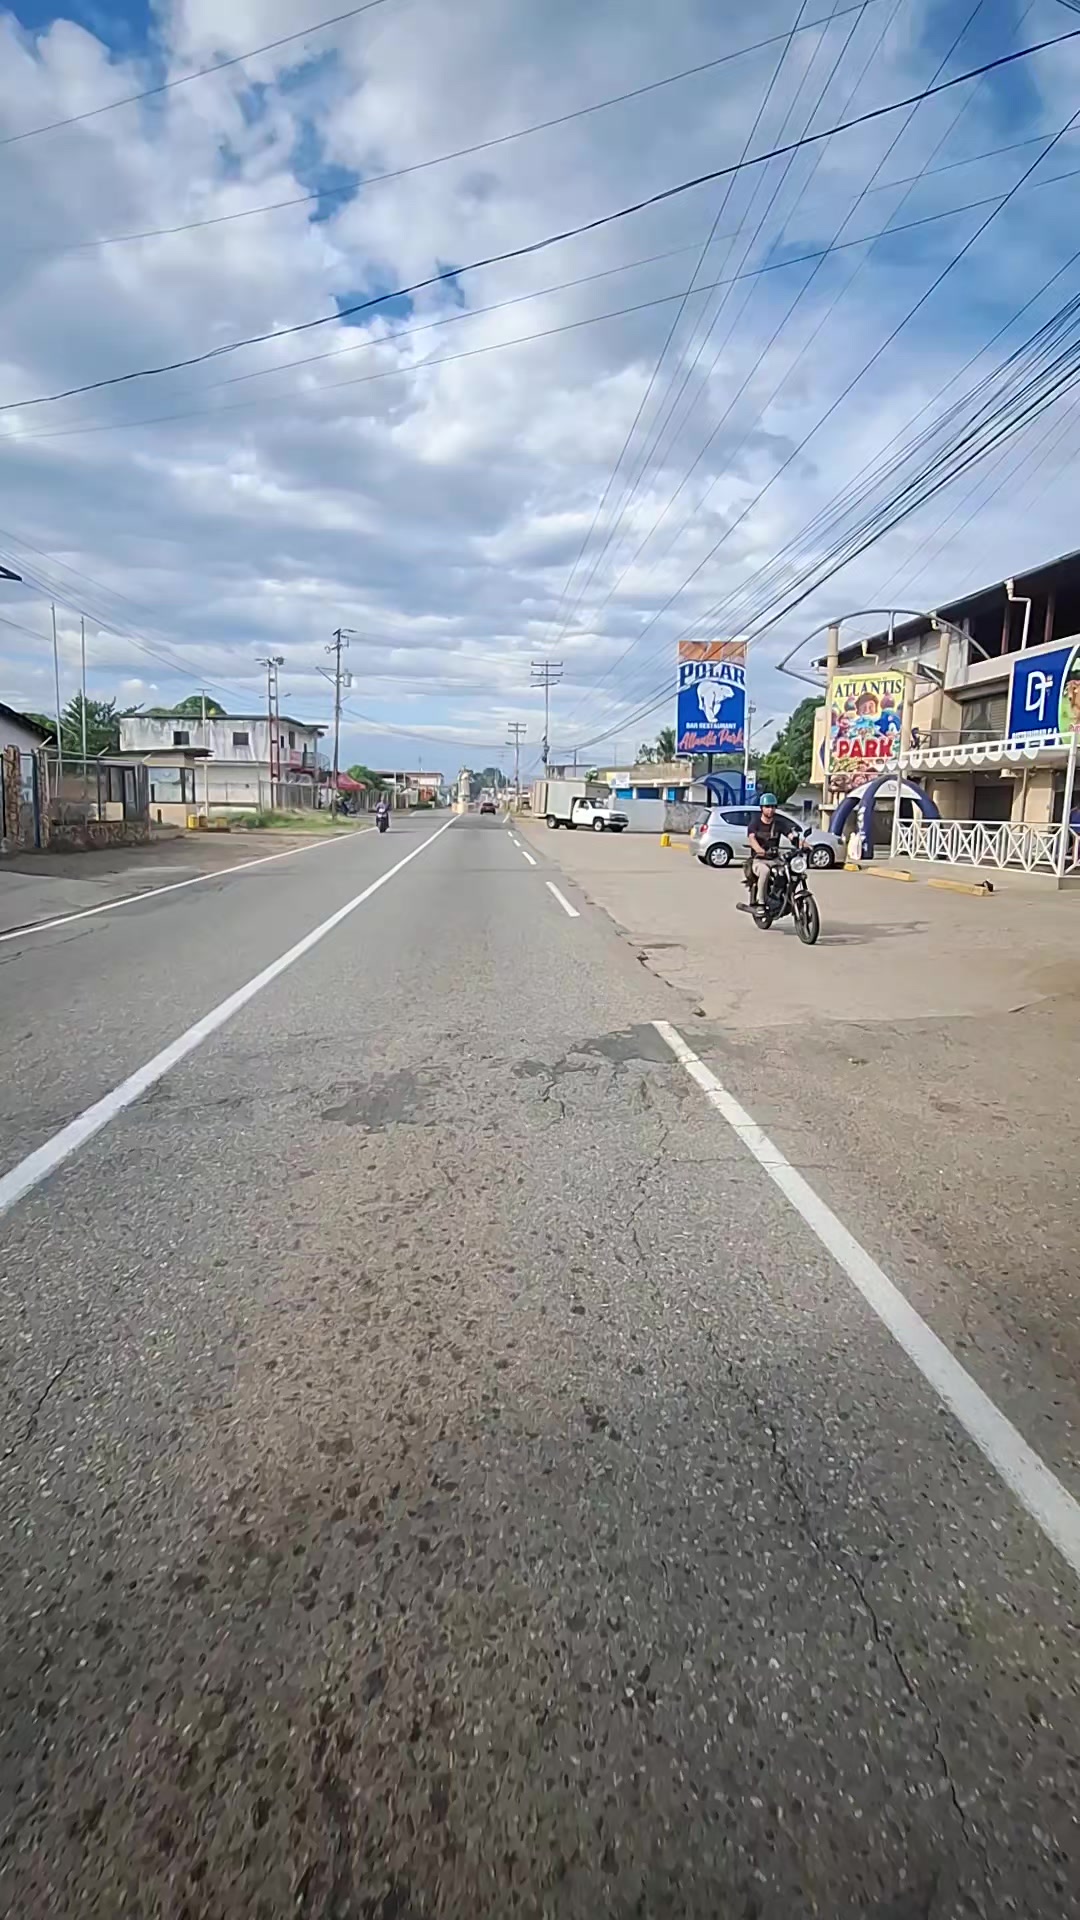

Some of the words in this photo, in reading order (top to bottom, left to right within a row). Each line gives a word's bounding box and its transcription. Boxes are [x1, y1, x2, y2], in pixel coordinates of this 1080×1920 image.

[680, 662, 745, 688] POLAR
[834, 679, 902, 698] ATLANTIS
[837, 738, 893, 758] PARK
